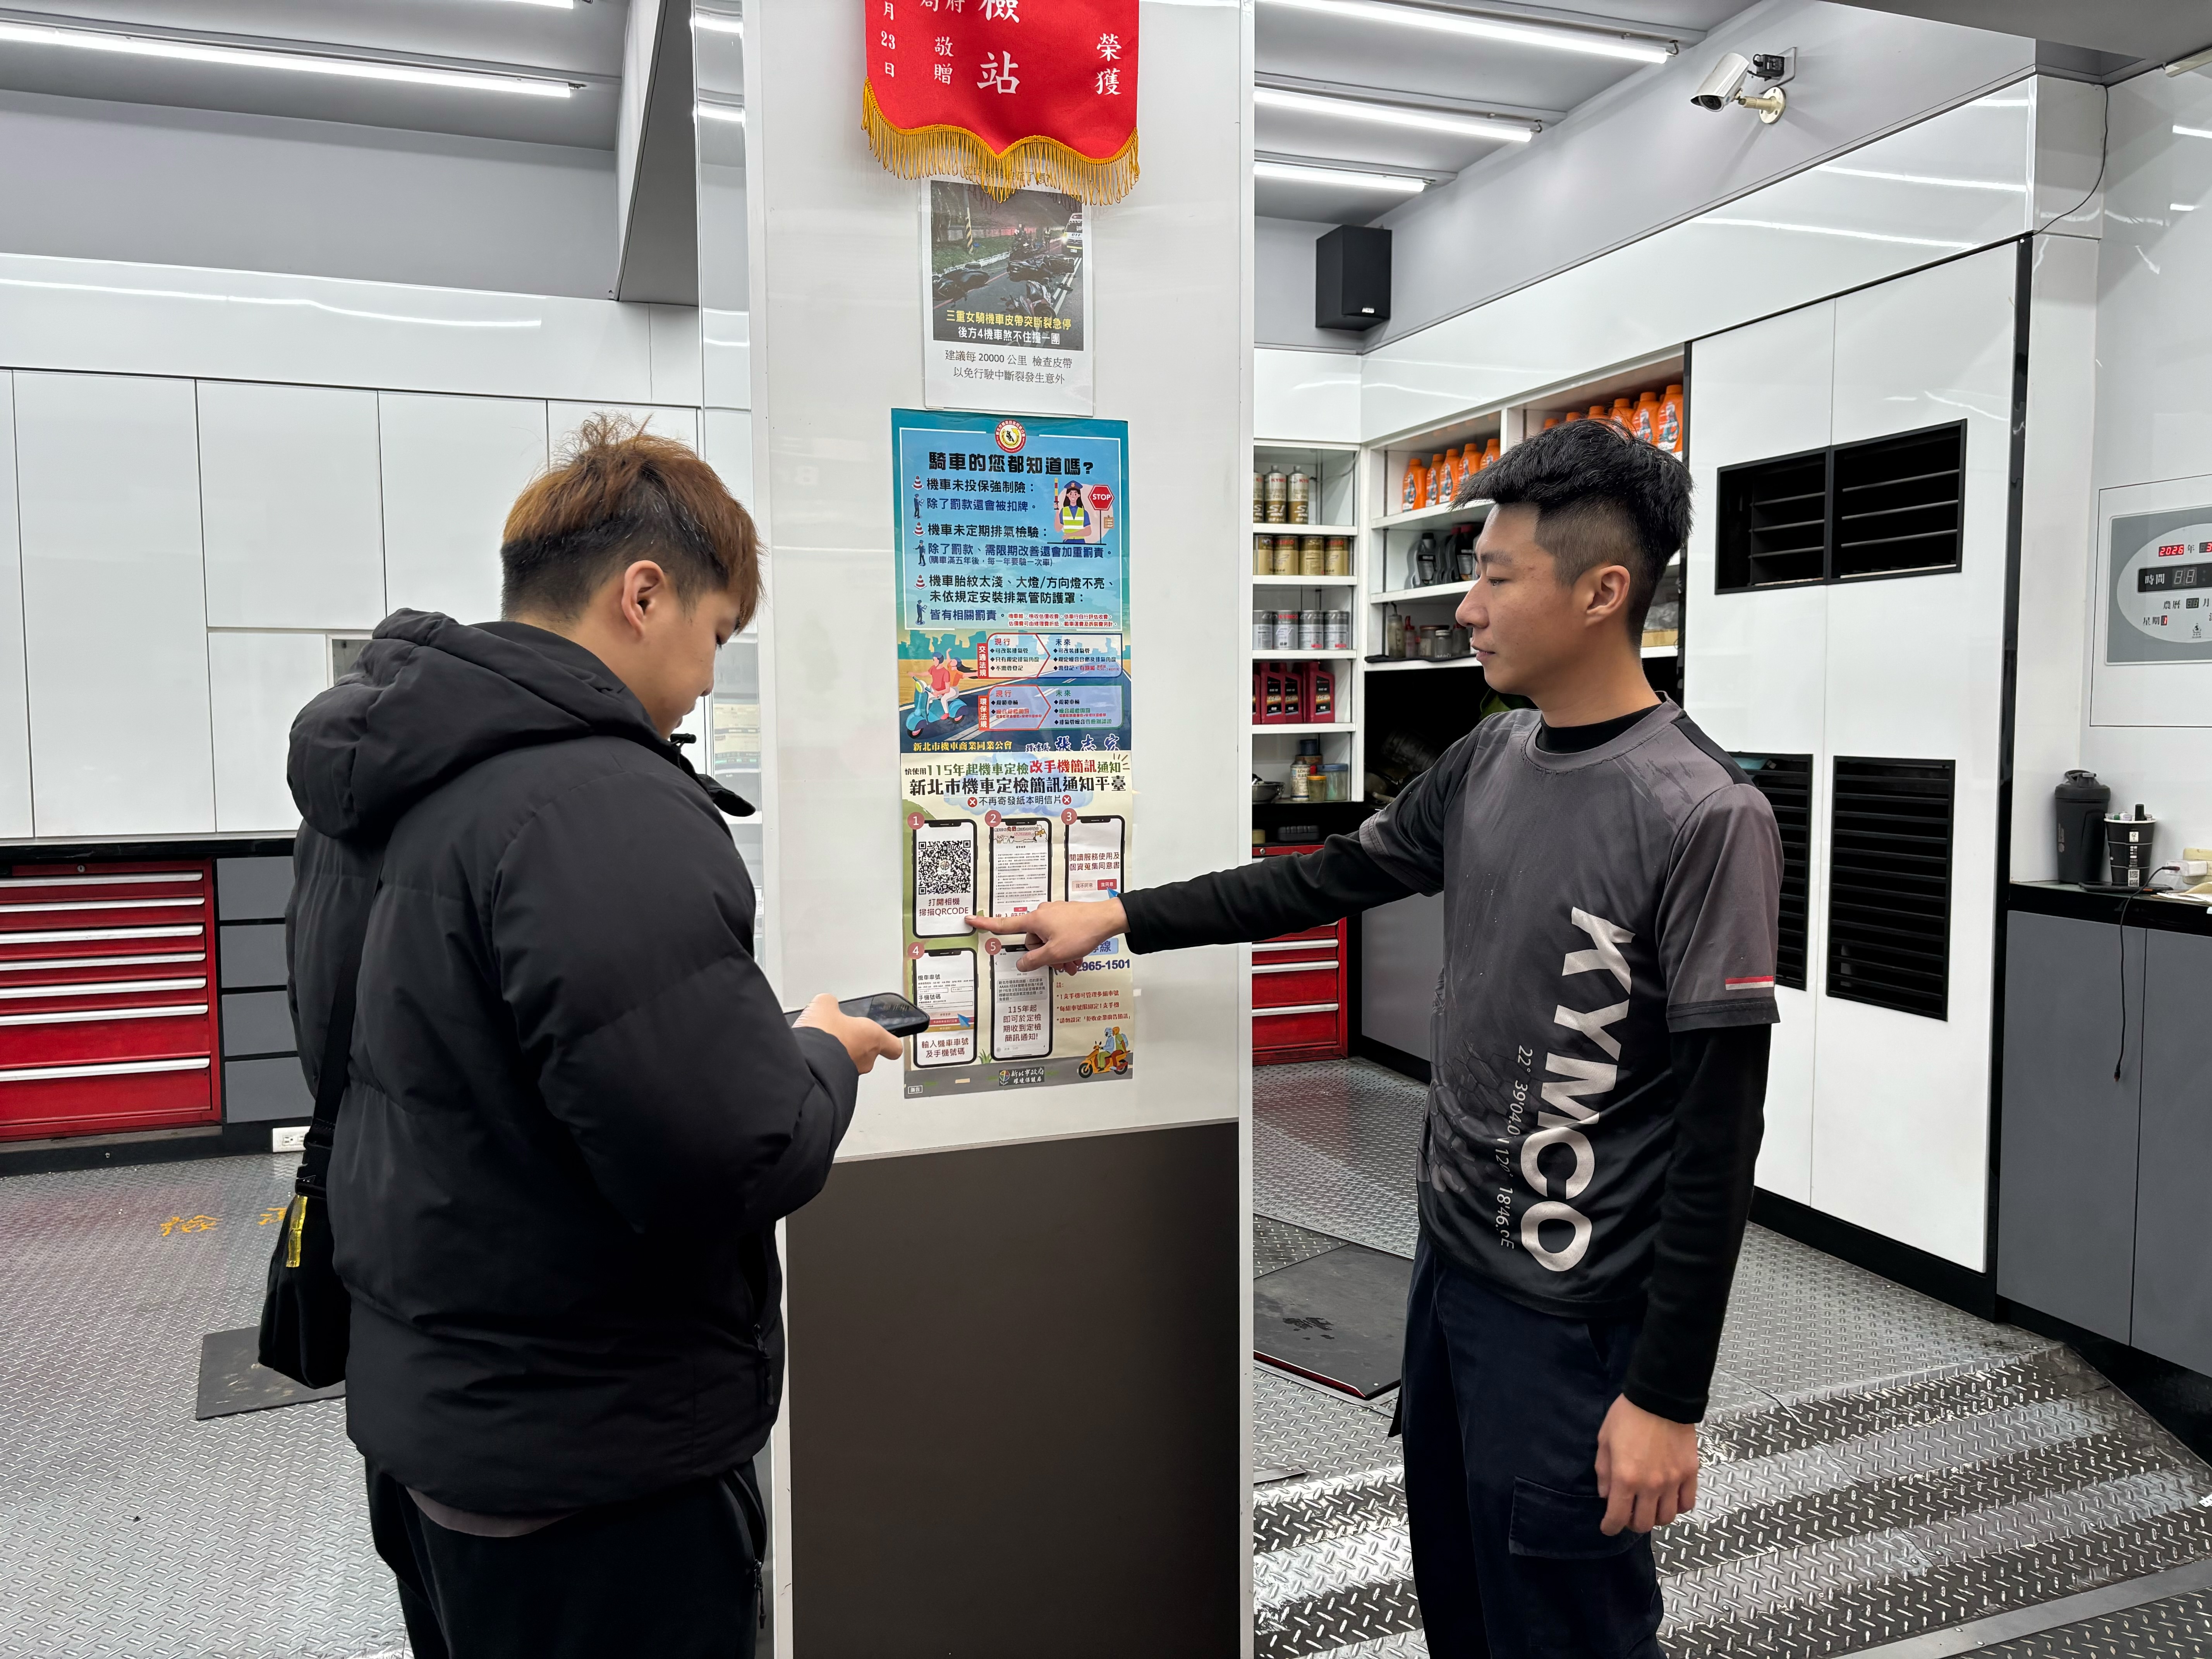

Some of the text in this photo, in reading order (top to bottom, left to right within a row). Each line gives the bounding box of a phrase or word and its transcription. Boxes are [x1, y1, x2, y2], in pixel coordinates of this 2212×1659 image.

[934, 36, 954, 85] 敬贈
[1094, 33, 1122, 96] 榮獲
[946, 309, 1072, 330] 三重女騎機車皮帶突斷裂急停
[945, 350, 1073, 369] 建議每 20000 公里 檢查皮帶
[953, 367, 1065, 385] 以免行駛中斷裂發生意外
[929, 451, 1094, 476] 騎車的您都知道嗎?
[1092, 493, 1111, 501] STOP
[2160, 545, 2184, 556] 2026
[2187, 544, 2195, 553] 年
[2145, 573, 2165, 586] 時間
[2203, 598, 2210, 607] 月
[2143, 616, 2160, 626] 星期
[979, 646, 987, 677] 交通法規
[913, 741, 1012, 751] 新北市機車商業同業公會
[909, 775, 1127, 796] 新北市機車定檢簡訊通知平臺
[979, 795, 1061, 806] 不再寄發紙本明信片
[913, 816, 919, 826] 1
[990, 814, 996, 824] 2
[1066, 812, 1072, 821] 3
[928, 897, 960, 907] 打開相機
[919, 907, 969, 917] 掃描QRCODE
[912, 946, 919, 955] 4
[990, 941, 996, 951] 5
[1008, 1004, 1037, 1013] 115年起
[1003, 1013, 1041, 1023] 即可於定檢
[1003, 1023, 1041, 1033] 期收到定檢
[1005, 1033, 1038, 1042] 簡訊通知!
[922, 1037, 969, 1049] 輸入機車車號
[926, 1047, 965, 1058] 及手機號碼
[1520, 906, 1636, 1272] KYMCO
